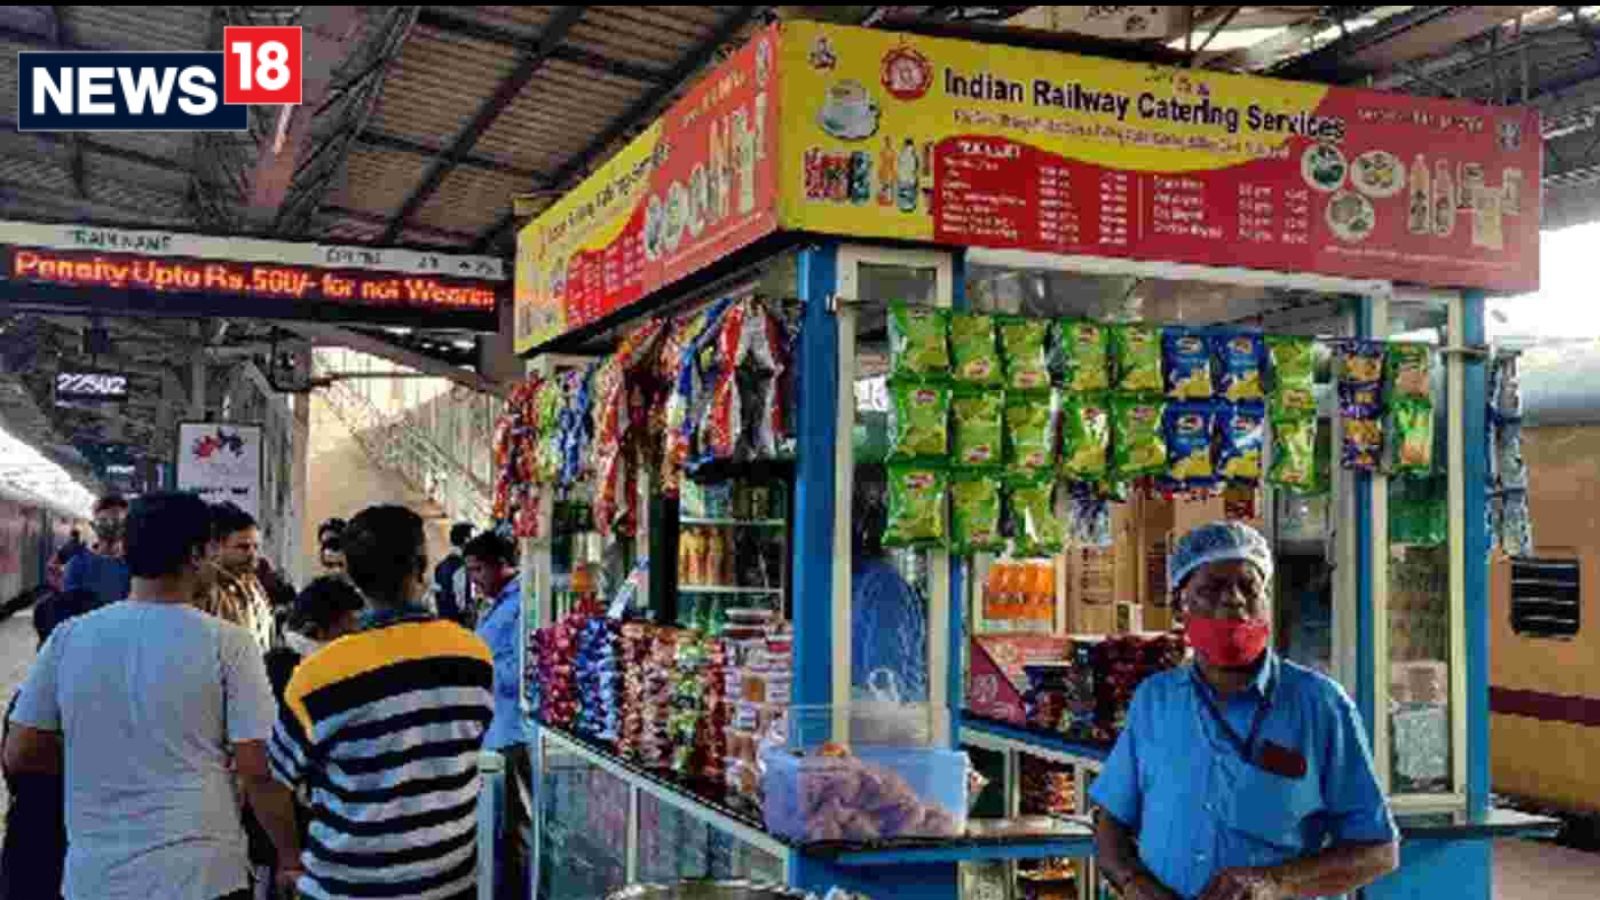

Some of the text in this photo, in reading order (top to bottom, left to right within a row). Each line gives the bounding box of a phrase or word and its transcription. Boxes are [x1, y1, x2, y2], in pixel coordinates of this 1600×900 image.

[944, 67, 1024, 103] Indian
[1032, 79, 1130, 121] Railway
[1137, 92, 1239, 133] Catering
[1246, 103, 1346, 140] Services
[131, 260, 200, 290] Upto
[321, 272, 355, 298] for
